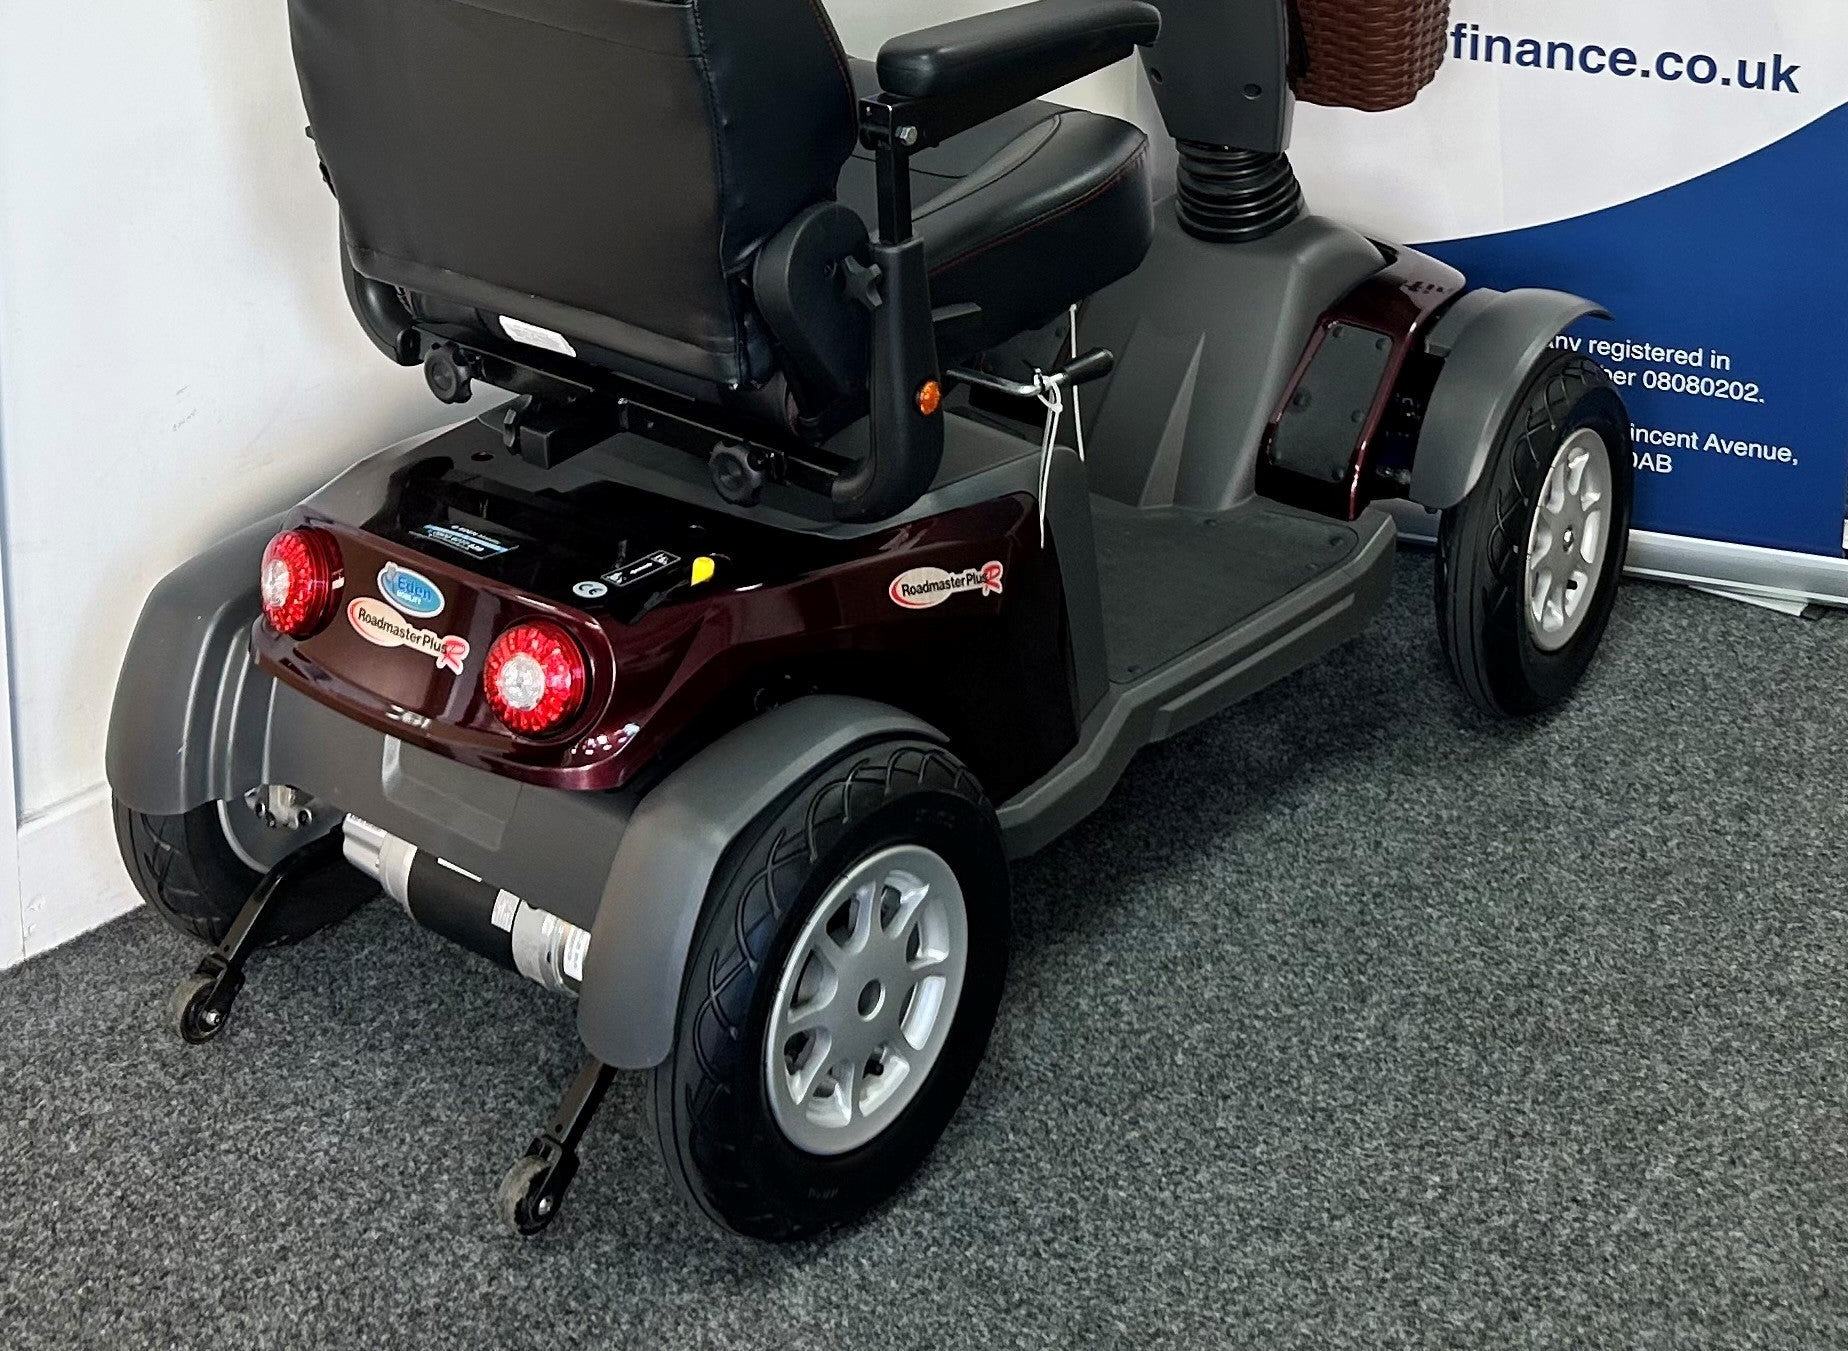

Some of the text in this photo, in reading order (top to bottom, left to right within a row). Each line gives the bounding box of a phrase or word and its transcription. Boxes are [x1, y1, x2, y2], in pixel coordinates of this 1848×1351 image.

[1449, 23, 1802, 94] finance.co.uk
[1588, 339, 1704, 367] registered
[1710, 349, 1731, 370] in
[1642, 369, 1765, 404] 08080202.
[1630, 422, 1799, 467] incent Avenue,
[398, 576, 431, 601] Eden
